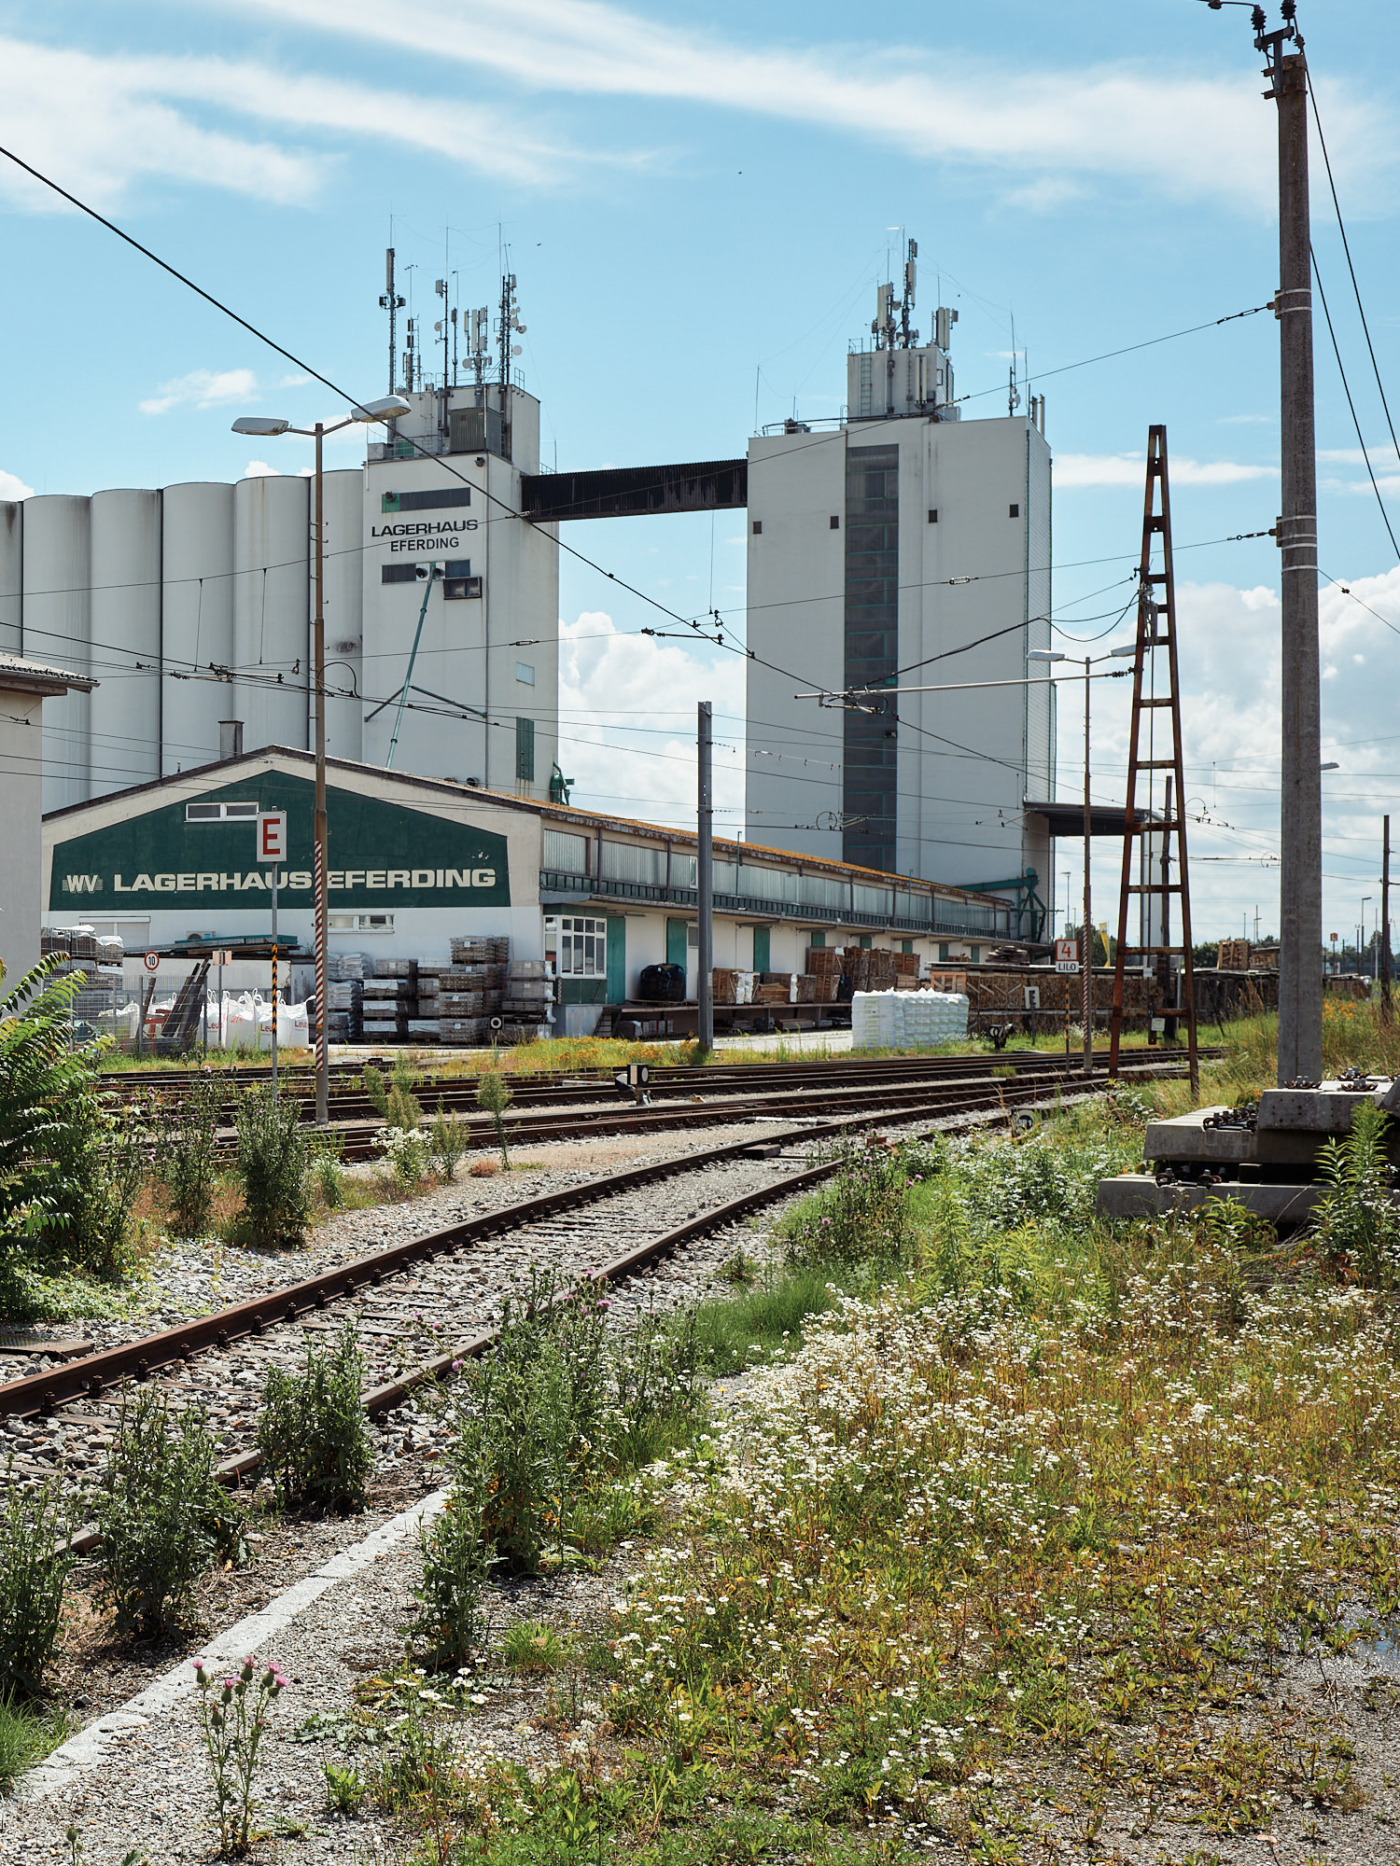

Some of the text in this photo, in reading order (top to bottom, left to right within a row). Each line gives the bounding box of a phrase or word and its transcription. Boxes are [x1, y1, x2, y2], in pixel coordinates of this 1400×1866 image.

[371, 519, 479, 537] LAGERHAUS
[390, 537, 460, 552] EFERDING
[263, 818, 280, 855] E
[66, 868, 497, 893] WV LAGERHAUS EFERDING
[1062, 942, 1071, 958] 4
[148, 956, 156, 966] 10
[1058, 963, 1076, 971] LILO
